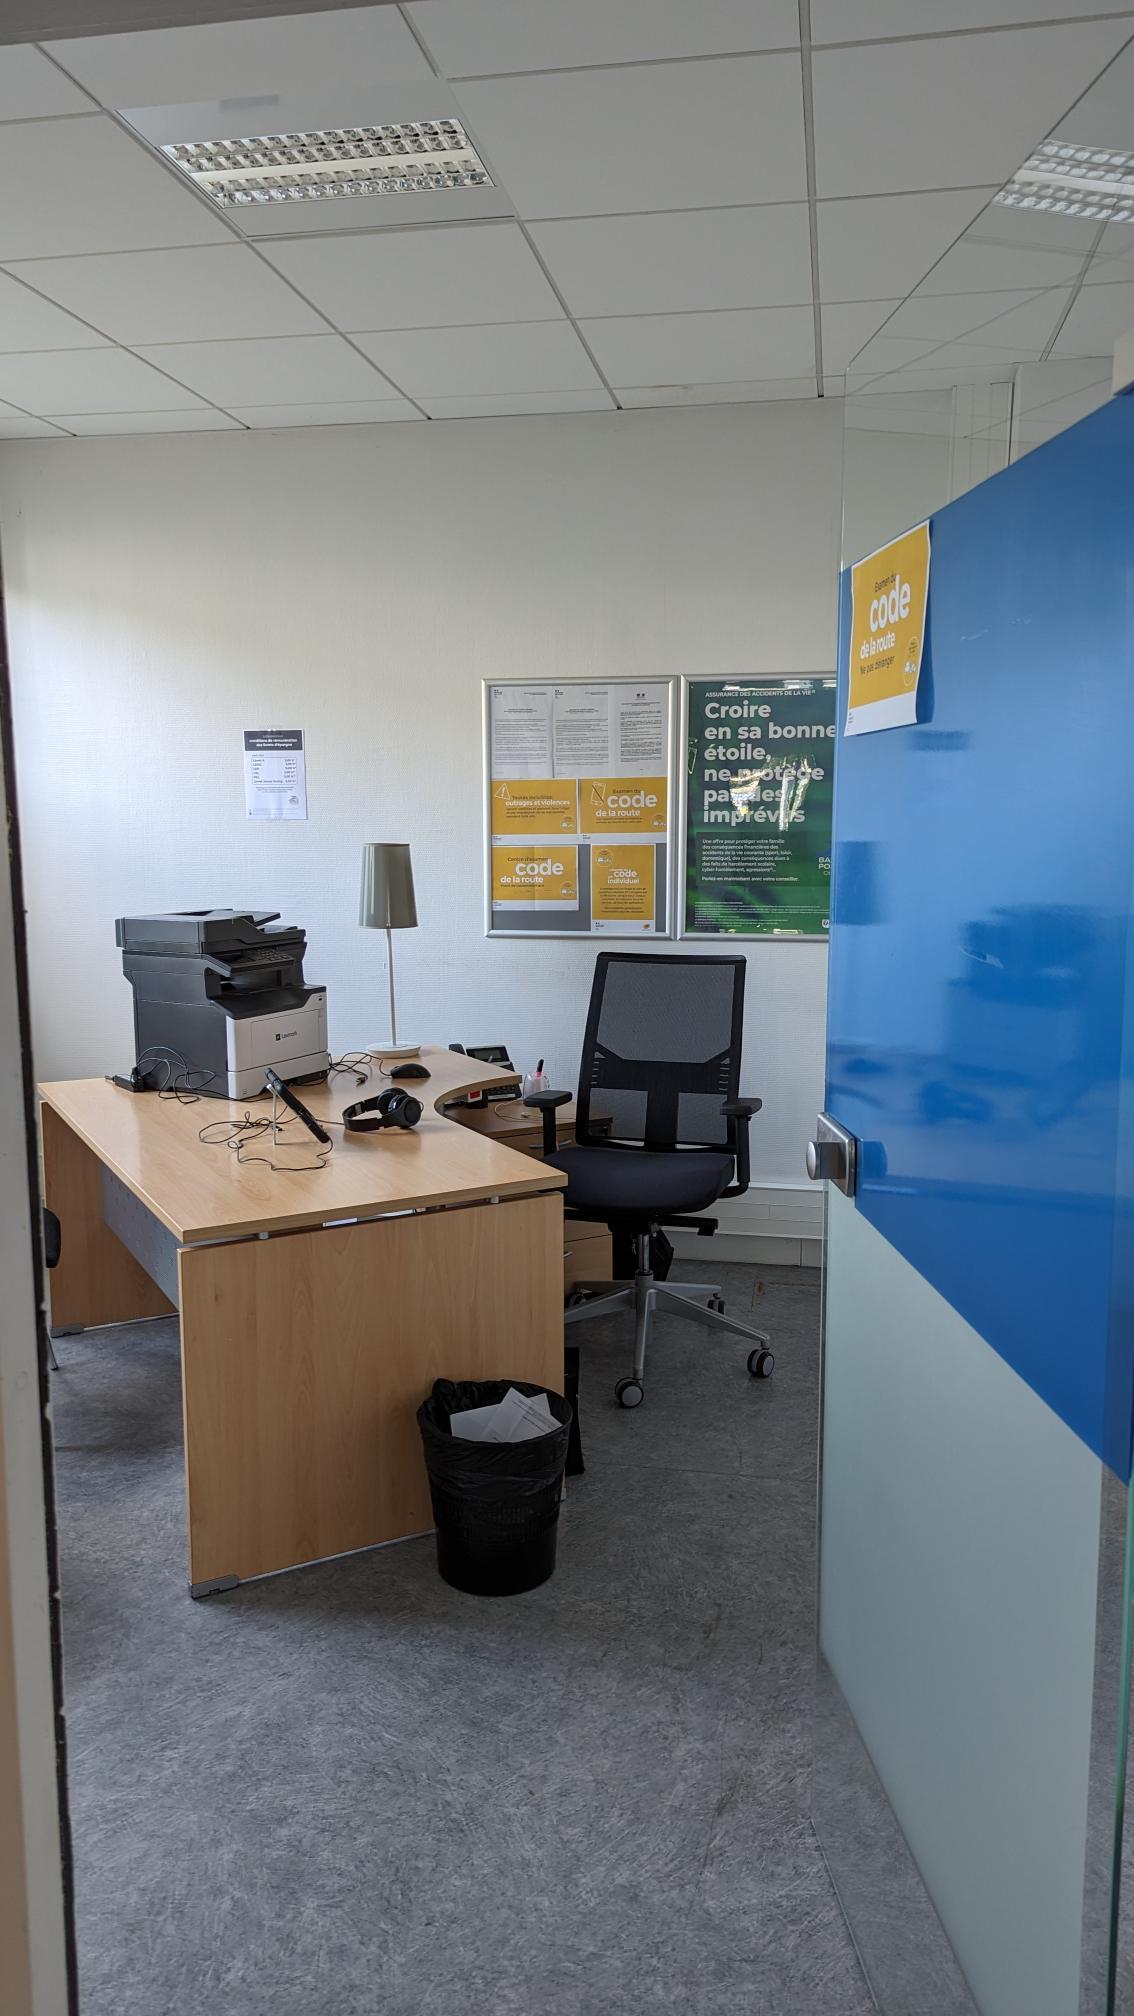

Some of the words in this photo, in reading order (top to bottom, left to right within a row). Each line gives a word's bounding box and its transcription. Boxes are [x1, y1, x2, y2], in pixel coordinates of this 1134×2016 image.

[875, 576, 890, 592] Examen
[870, 574, 911, 632] code
[860, 641, 869, 659] de
[870, 637, 876, 656] la
[876, 632, 896, 653] route
[704, 700, 772, 718] Croire
[704, 726, 732, 740] en
[738, 726, 762, 739] sa
[768, 722, 836, 738] bonne
[704, 743, 771, 762] étoile,
[704, 768, 732, 782] ne
[607, 791, 658, 808] code
[704, 789, 740, 805] pa
[516, 859, 564, 876] code
[614, 869, 638, 877] code
